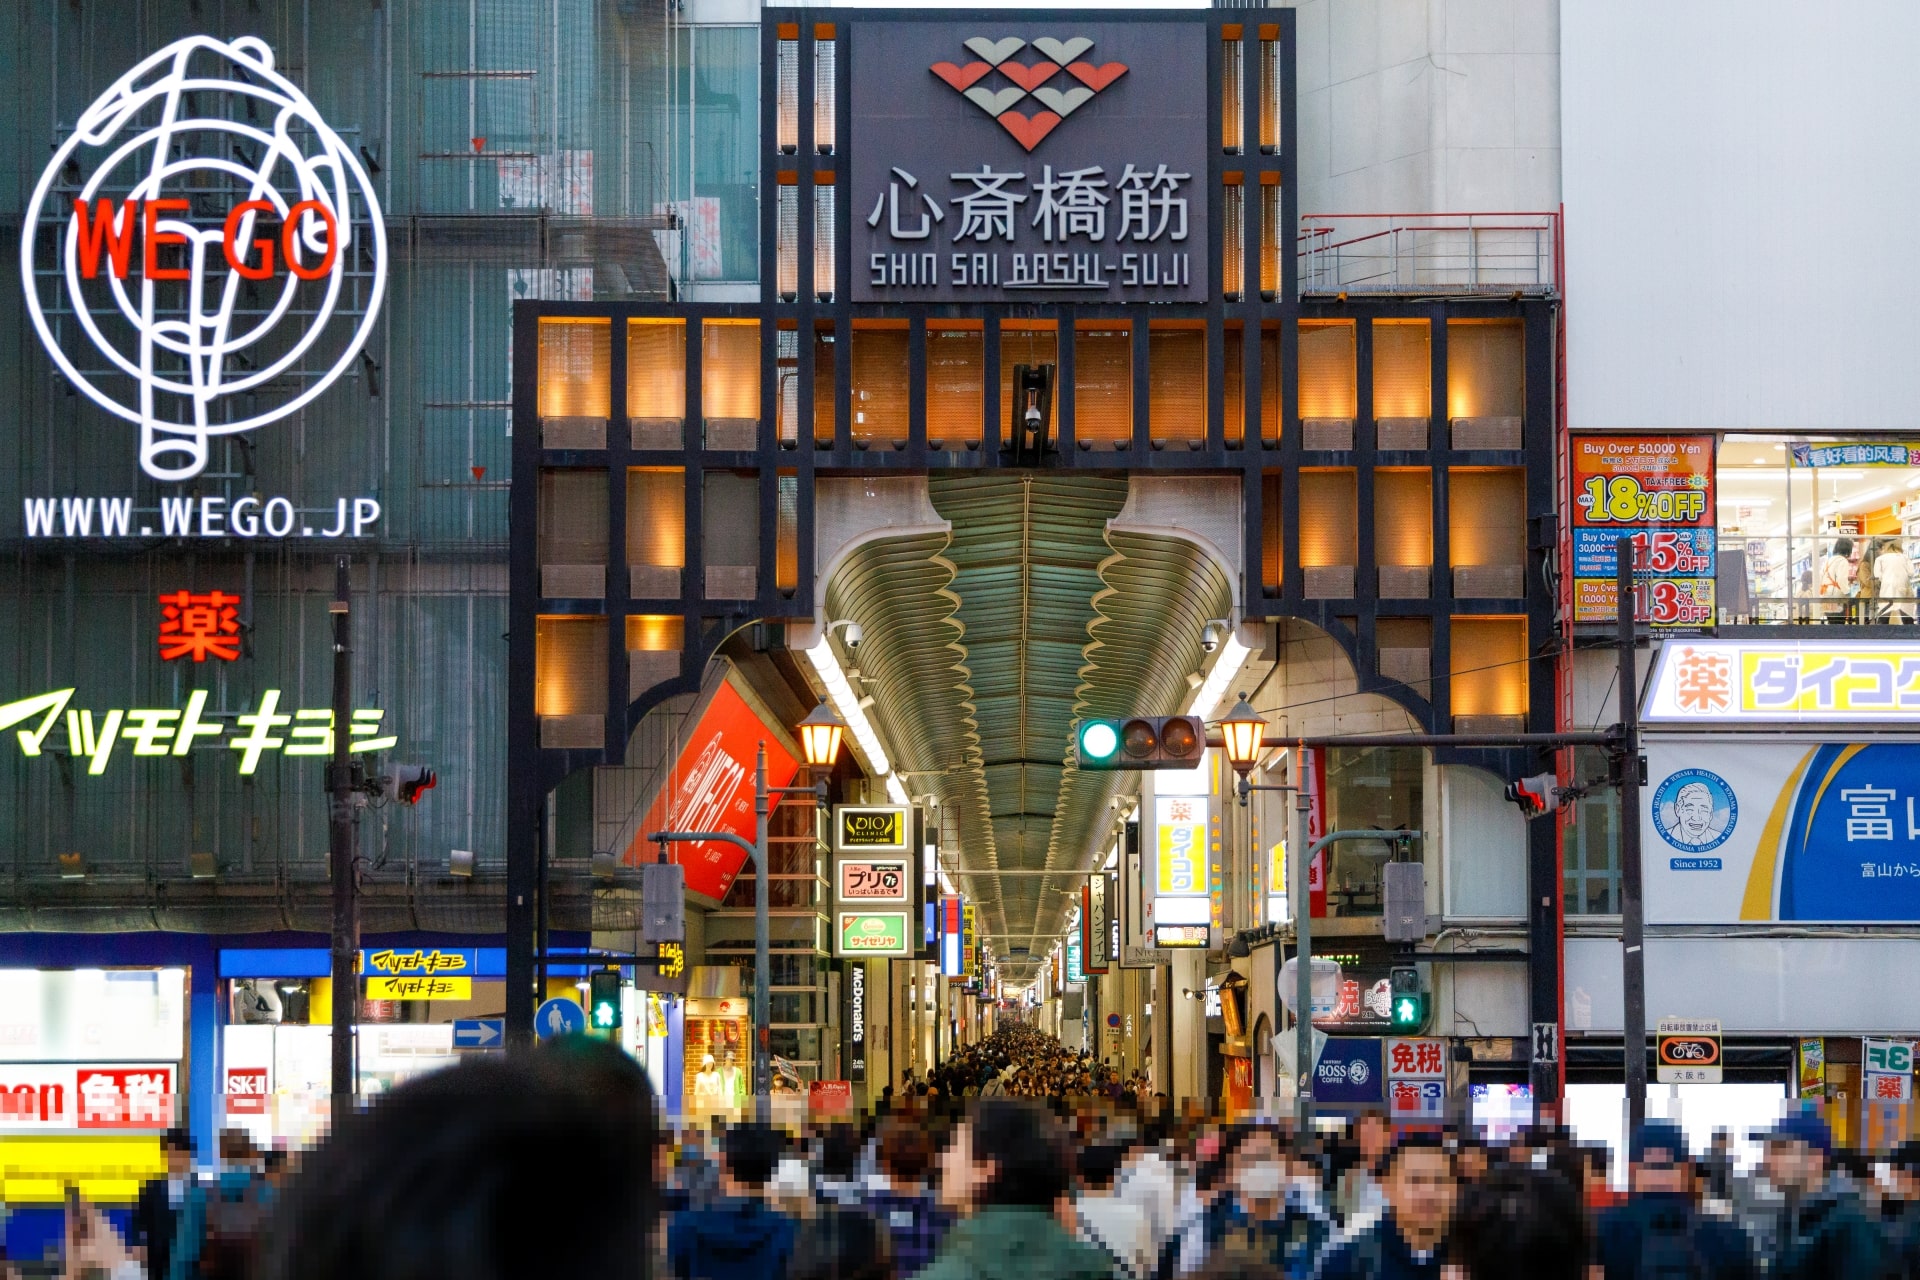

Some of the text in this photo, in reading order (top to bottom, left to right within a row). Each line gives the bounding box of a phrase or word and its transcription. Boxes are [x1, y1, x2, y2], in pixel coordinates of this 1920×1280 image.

[867, 164, 1191, 242] 心斎橋筋
[871, 253, 936, 286] SHIN
[952, 253, 997, 286] SAI
[1583, 443, 1700, 455] Buy Over 50,000 Yen
[1810, 446, 1907, 467] 看好看的风景
[1645, 477, 1686, 486] TAX-FREE
[24, 497, 381, 537] WWW.WEGO.JP
[1582, 533, 1598, 542] Buy
[1679, 532, 1693, 540] MAX
[1579, 543, 1605, 553] 30,000
[1677, 556, 1710, 571] OFF
[1583, 584, 1617, 593] Buy Ove
[1580, 595, 1607, 604] 10,000
[1679, 606, 1711, 622] OFF
[158, 590, 241, 662] 薬
[1679, 647, 1730, 710] 薬
[0, 688, 398, 774] マツモトキヨシ
[1841, 784, 1920, 841] 富
[856, 816, 885, 829] DIO
[1172, 825, 1193, 889] ダイコク
[1674, 860, 1718, 868] Since 1952
[849, 871, 881, 889] プリ
[885, 875, 897, 886] 7F
[851, 936, 896, 946] サイゼリヤ
[372, 950, 466, 974] マツモトキヨシ
[384, 978, 455, 997] マツモトキヨシ
[852, 967, 864, 1042] McDonald's
[1660, 1024, 1718, 1032] 自転車放置禁止区域
[1391, 1043, 1443, 1074] 免税
[1318, 1065, 1347, 1077] BOSS
[1674, 1071, 1706, 1080] 大阪市
